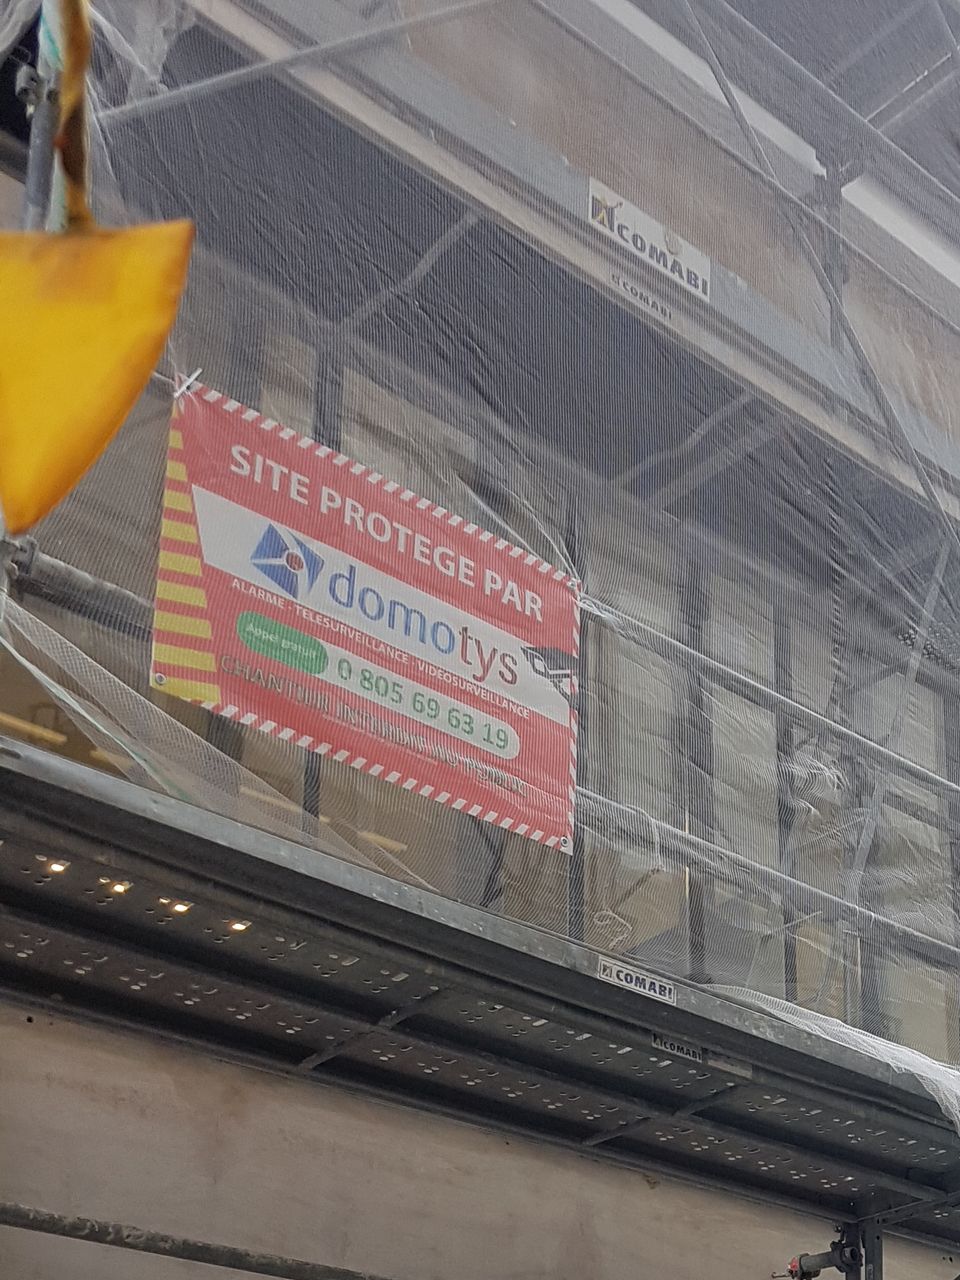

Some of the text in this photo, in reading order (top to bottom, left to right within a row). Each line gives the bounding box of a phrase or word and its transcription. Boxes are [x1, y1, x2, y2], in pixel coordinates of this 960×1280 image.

[230, 445, 543, 623] SITE PROTEGE PAR
[232, 578, 530, 719] ALARME TELESURVEILLANCE VIDEOSURVEILLANCE
[246, 622, 318, 660] Appel gratuit
[329, 563, 518, 685] domotys
[337, 657, 509, 750] 0 805 69 63 19
[616, 969, 673, 1000] COMABI
[664, 1038, 701, 1061] COMABI
